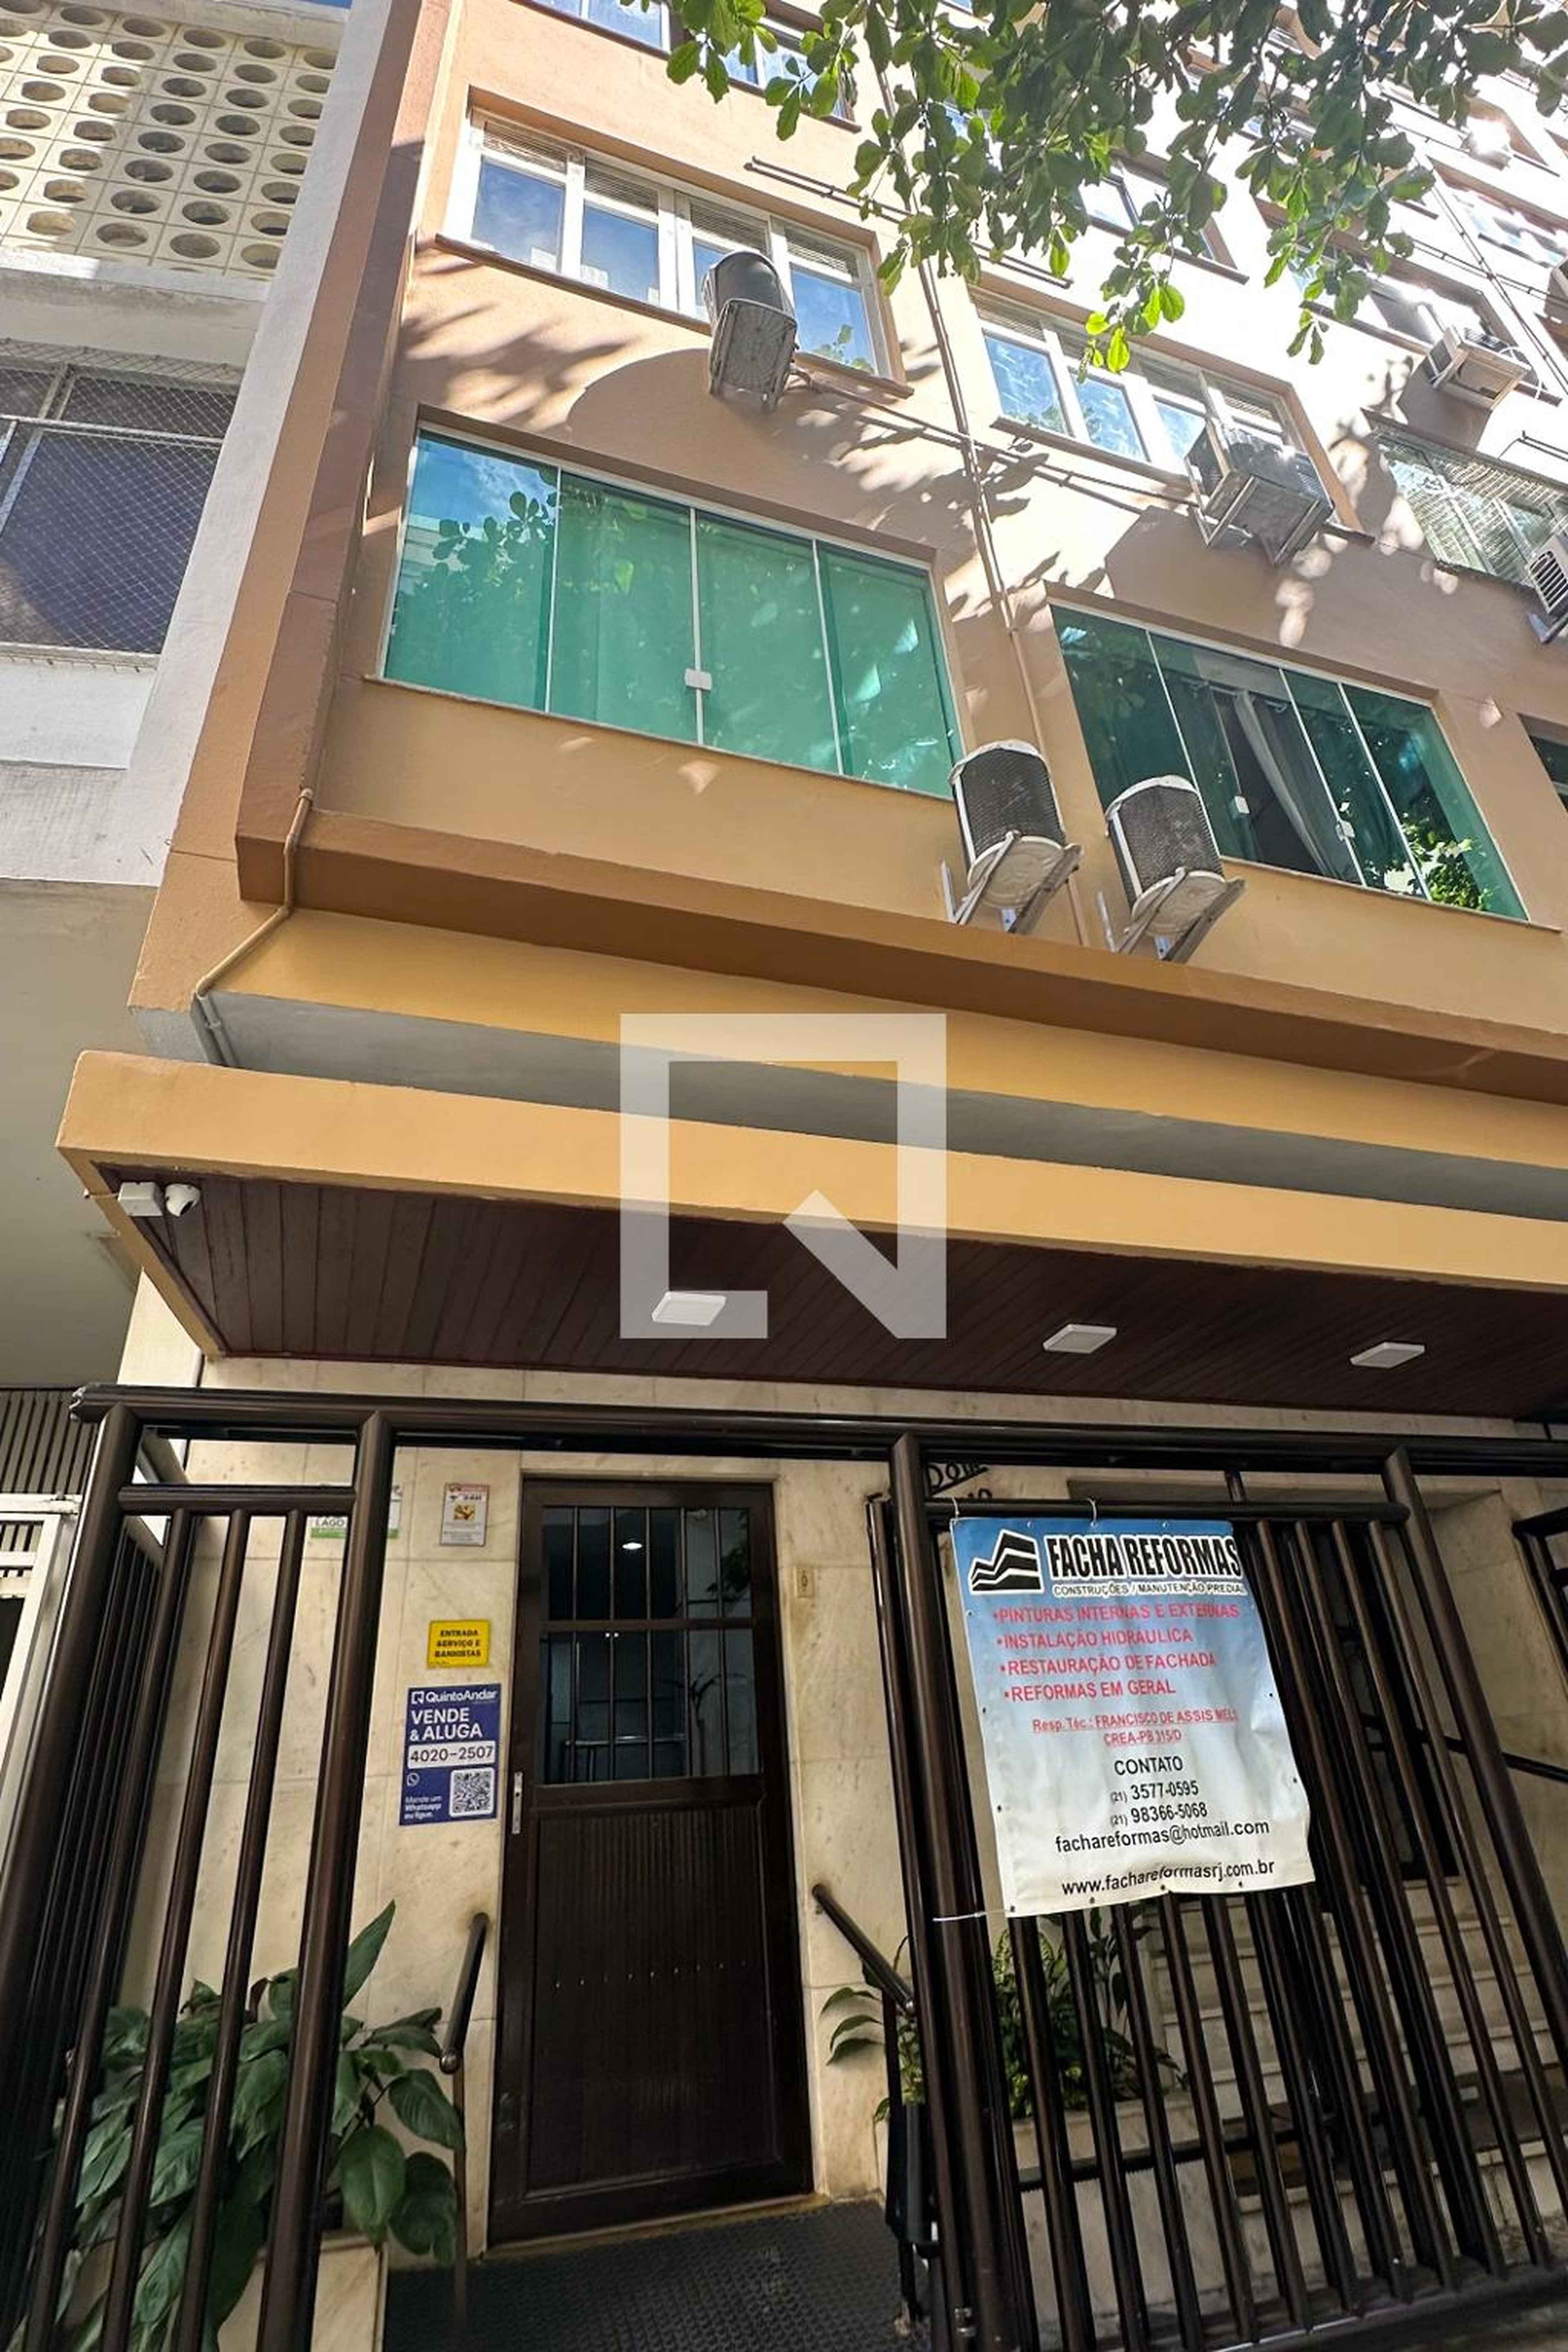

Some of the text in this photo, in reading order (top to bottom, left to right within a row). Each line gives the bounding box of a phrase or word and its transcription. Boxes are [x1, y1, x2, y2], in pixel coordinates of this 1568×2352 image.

[1046, 1538, 1242, 1577] FACHA REFORMAS
[1054, 1583, 1129, 1595] CONSTRUÇÕES
[1138, 1581, 1204, 1593] MANUTENÇÃO
[1000, 1603, 1239, 1623] PINTURAS INTERNAS E EXTERNAS
[1004, 1630, 1097, 1649] INSTALAÇÃO
[1008, 1652, 1217, 1675] RESTAURAÇÃO DE FACHADA
[425, 1689, 497, 1703] QuintoAndar
[1011, 1678, 1176, 1701] REFORMAS EM GERAL
[411, 1708, 470, 1725] VENDE
[1096, 1712, 1158, 1728] FRANCISCO
[1160, 1711, 1174, 1724] DE
[1176, 1708, 1213, 1722] ASSIS
[410, 1723, 483, 1741] & ALUGA
[410, 1746, 493, 1762] 4020-2507
[1114, 1755, 1183, 1776] CONTATO
[1110, 1780, 1199, 1802] (21) 3577-0595
[1110, 1802, 1208, 1826] (21) 98366-5068
[1056, 1820, 1270, 1853] fachareformas@hotmail.com
[1062, 1859, 1275, 1895] www.fachareformasrj.com.br
